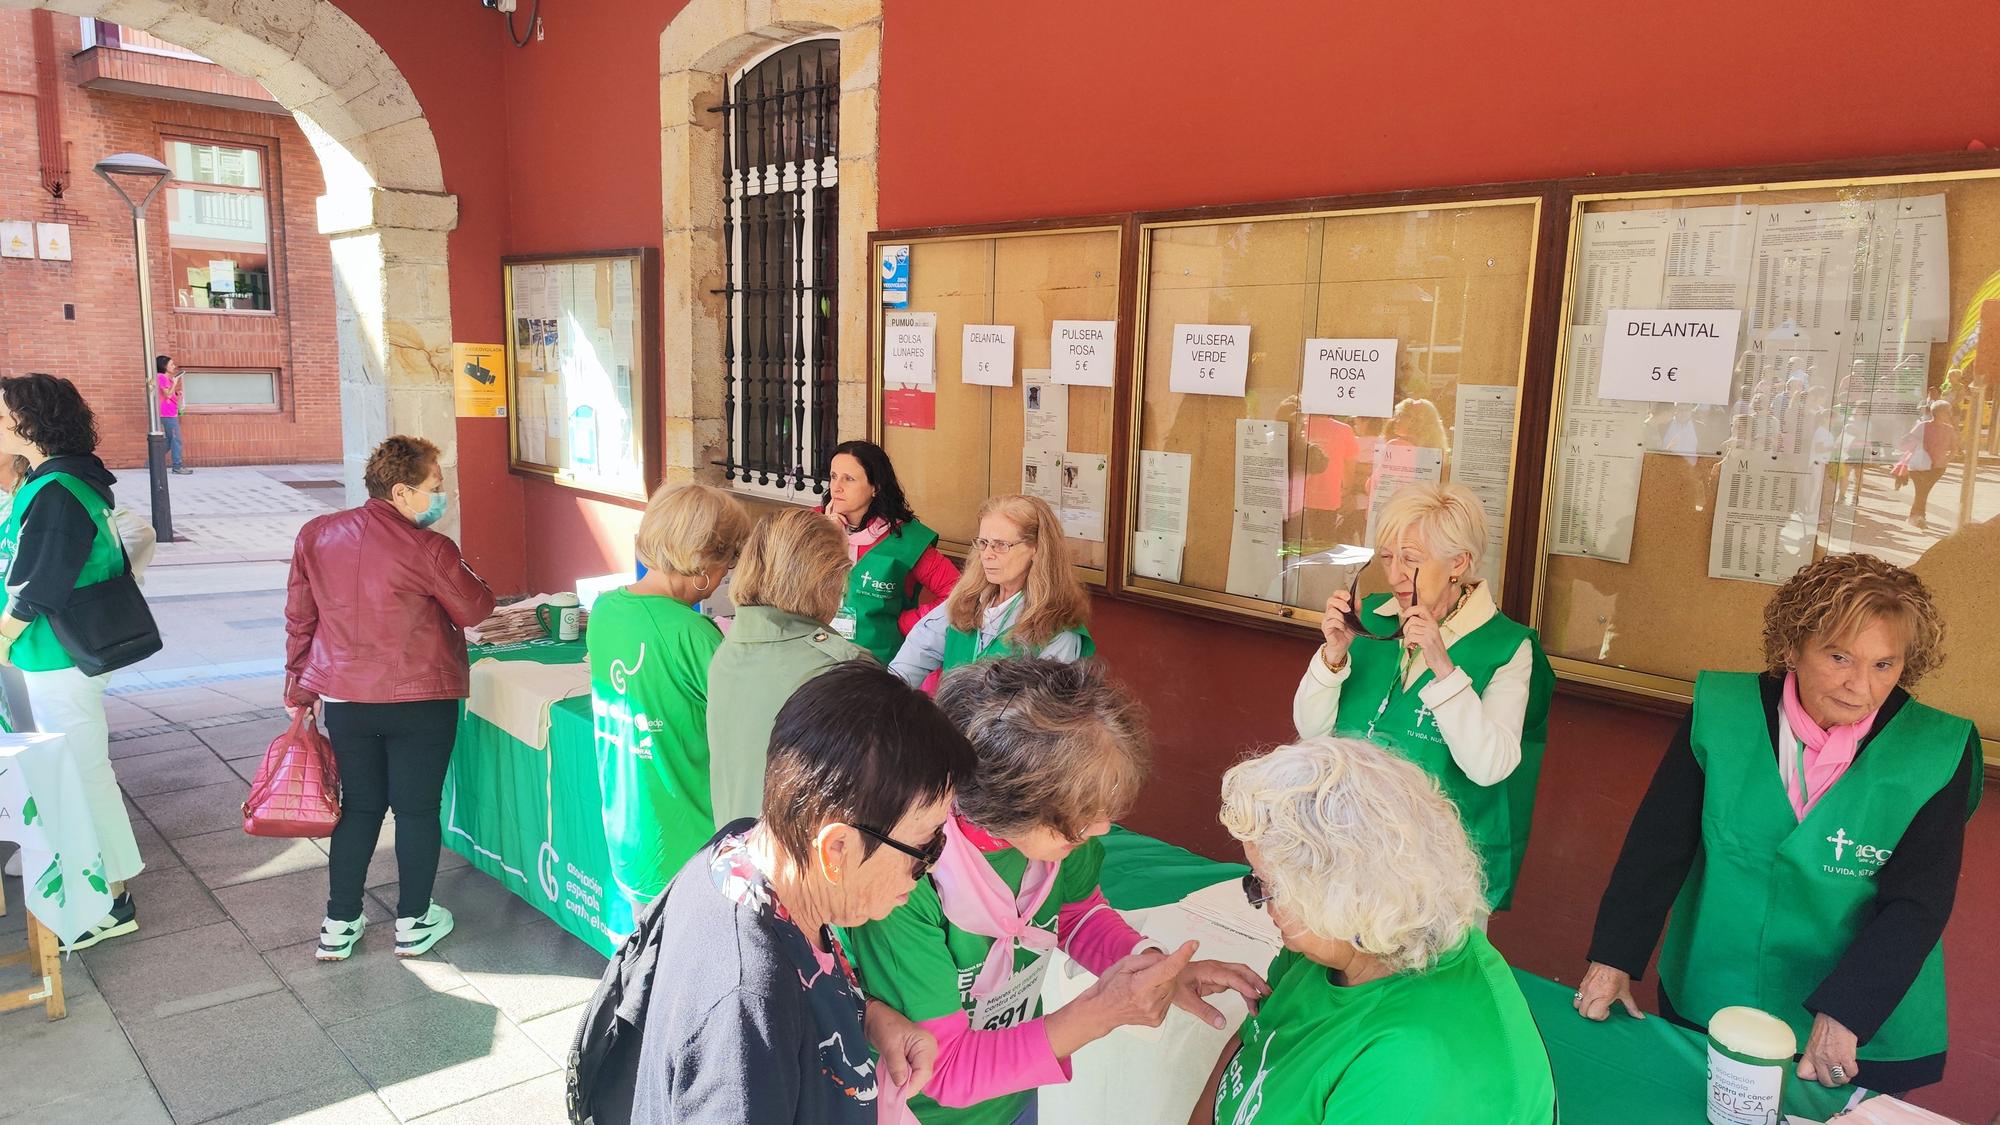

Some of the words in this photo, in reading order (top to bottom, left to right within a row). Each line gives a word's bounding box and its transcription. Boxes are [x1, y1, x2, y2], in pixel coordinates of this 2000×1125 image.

[891, 318, 914, 327] PUMUO
[1062, 329, 1103, 340] PULSERA
[1628, 322, 1719, 338] DELANTAL
[898, 334, 922, 344] BOLSA
[970, 333, 1005, 344] DELANTAL
[1185, 333, 1235, 346] PULSERA
[893, 348, 924, 357] LUNARES
[1069, 344, 1095, 356] ROSA
[1320, 346, 1379, 363] PAÑUELO
[1191, 350, 1226, 363] VERDE
[909, 362, 914, 370] €
[978, 362, 983, 372] 5
[984, 362, 990, 372] €
[1075, 360, 1080, 370] 5
[1081, 360, 1088, 371] €
[1199, 368, 1206, 379] 5
[1208, 368, 1215, 379] €
[1330, 368, 1365, 380] ROSA
[1651, 367, 1661, 382] 5
[1667, 367, 1678, 382] €
[1337, 387, 1345, 398] 3
[1347, 387, 1356, 399] €
[648, 718, 663, 728] edp
[1836, 867, 1857, 877] VIDA,
[566, 880, 600, 912] española
[566, 899, 590, 922] contra
[590, 915, 600, 928] el
[983, 997, 1029, 1030] 691
[1715, 1082, 1737, 1096] contra
[1713, 1085, 1764, 1112] BOLSA
